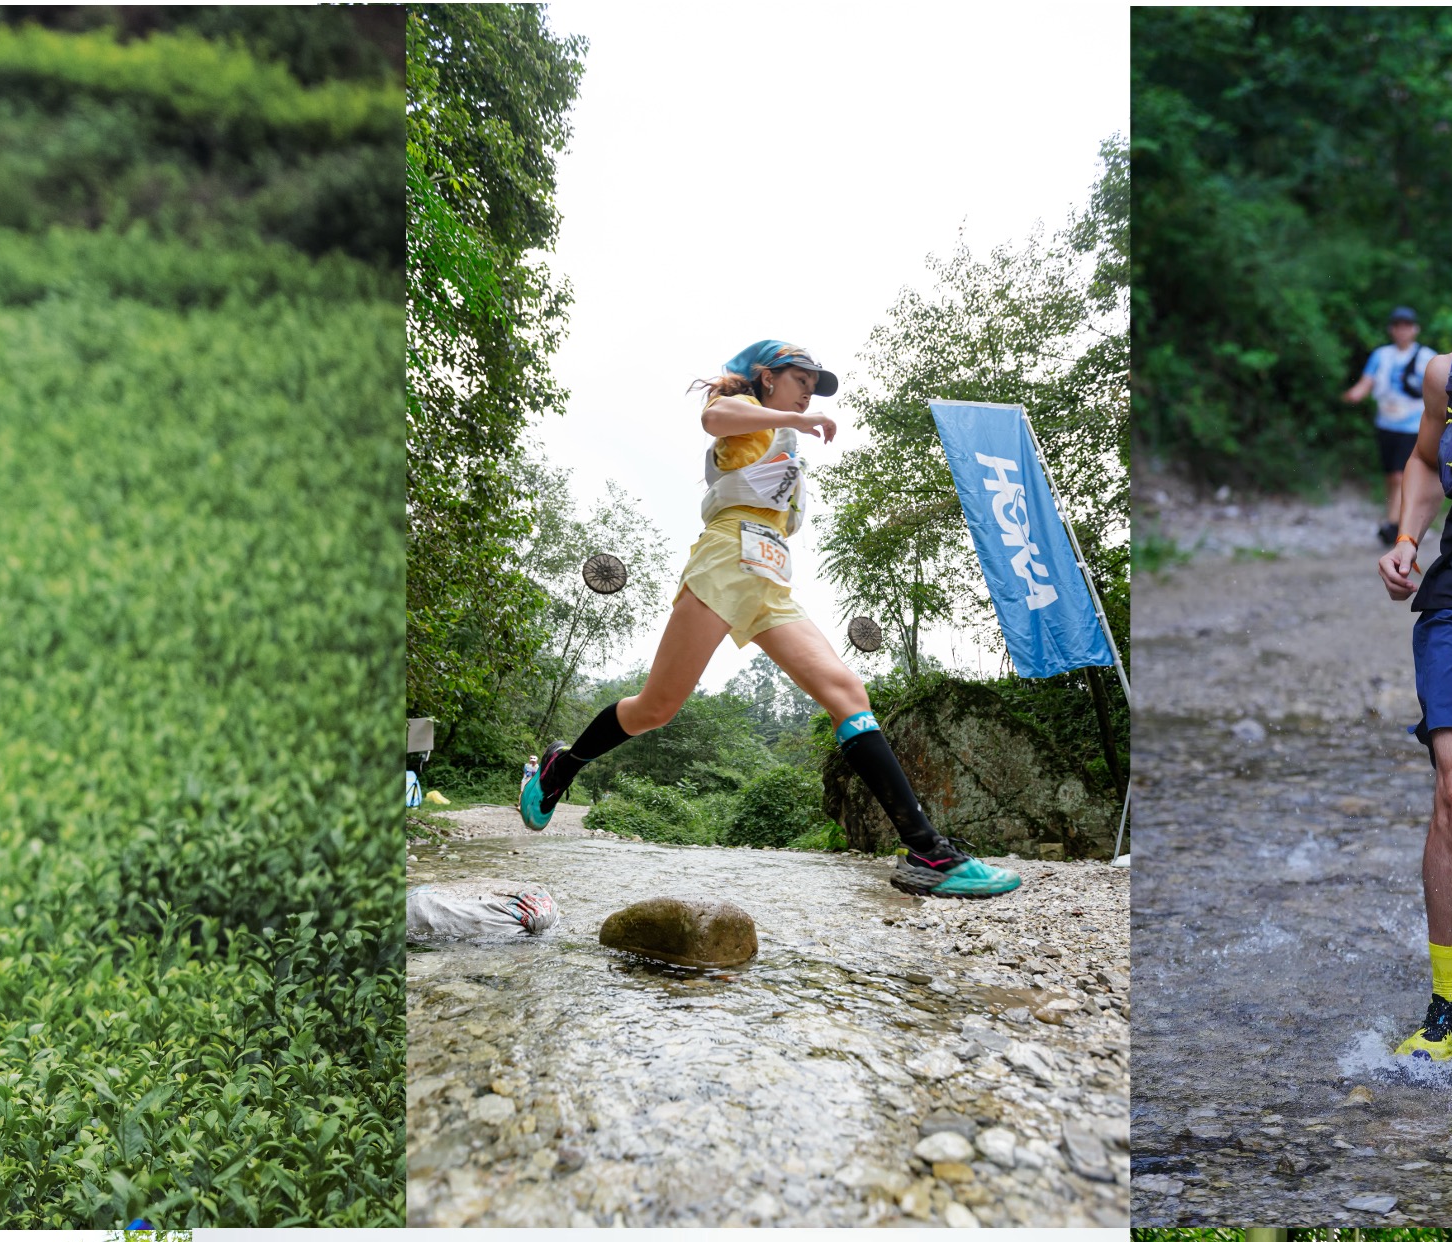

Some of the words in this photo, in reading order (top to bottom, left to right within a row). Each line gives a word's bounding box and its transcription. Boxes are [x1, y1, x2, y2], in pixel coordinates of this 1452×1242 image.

[771, 465, 799, 504] HOKA
[975, 452, 1059, 611] HOKA
[758, 541, 787, 569] 1537
